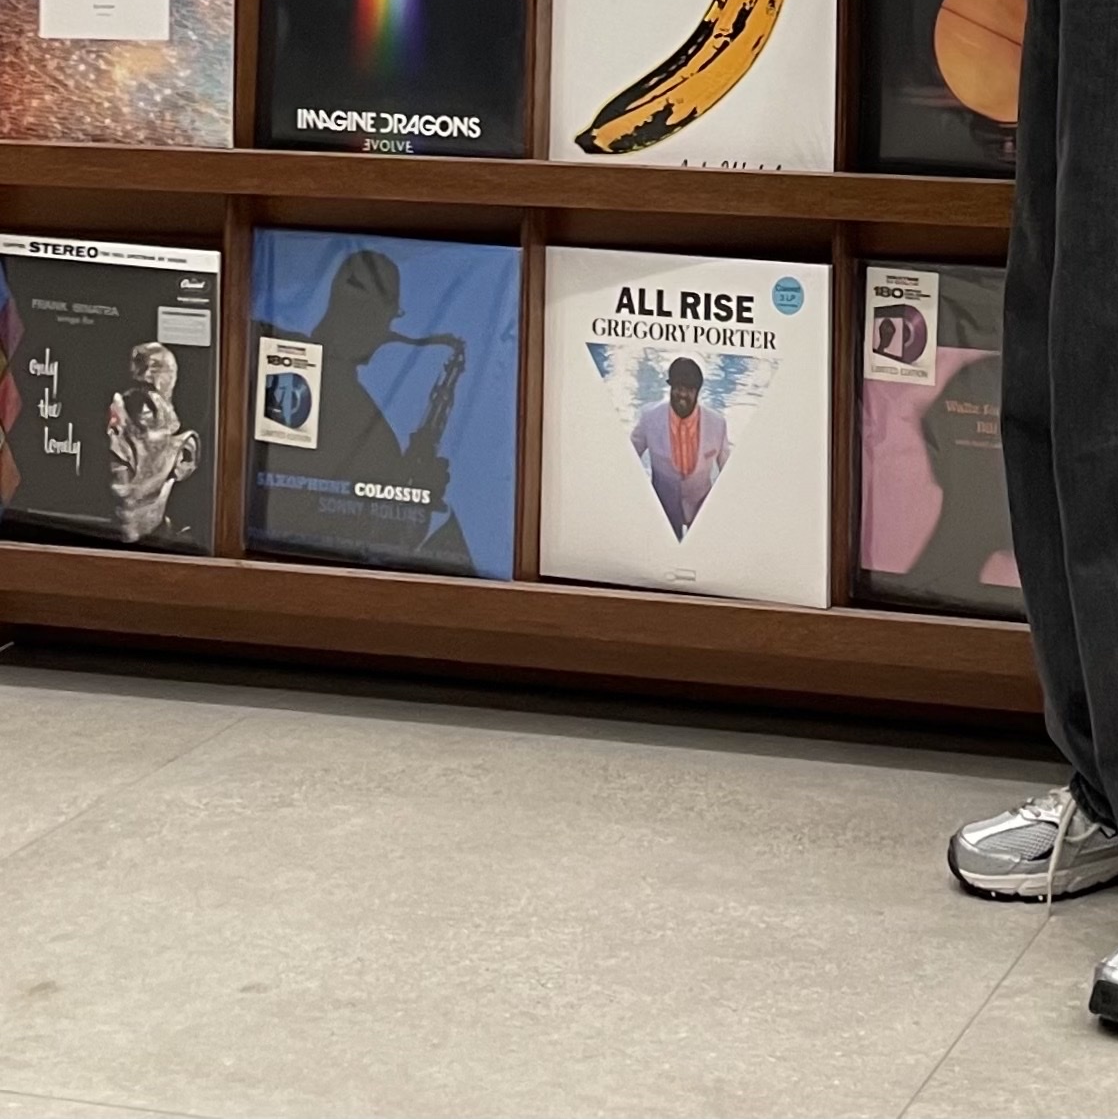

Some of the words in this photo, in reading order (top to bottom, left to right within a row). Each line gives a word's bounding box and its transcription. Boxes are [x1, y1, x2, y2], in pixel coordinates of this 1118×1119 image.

[297, 108, 377, 133] IMAGINE
[379, 112, 482, 139] DRAGONS
[29, 241, 99, 259] STEREO
[615, 287, 673, 318] ALL
[680, 291, 755, 324] RISE
[874, 286, 904, 299] 180
[592, 317, 692, 343] GREGORY
[693, 325, 777, 350] PORTER
[354, 482, 431, 504] COLOSSUS
